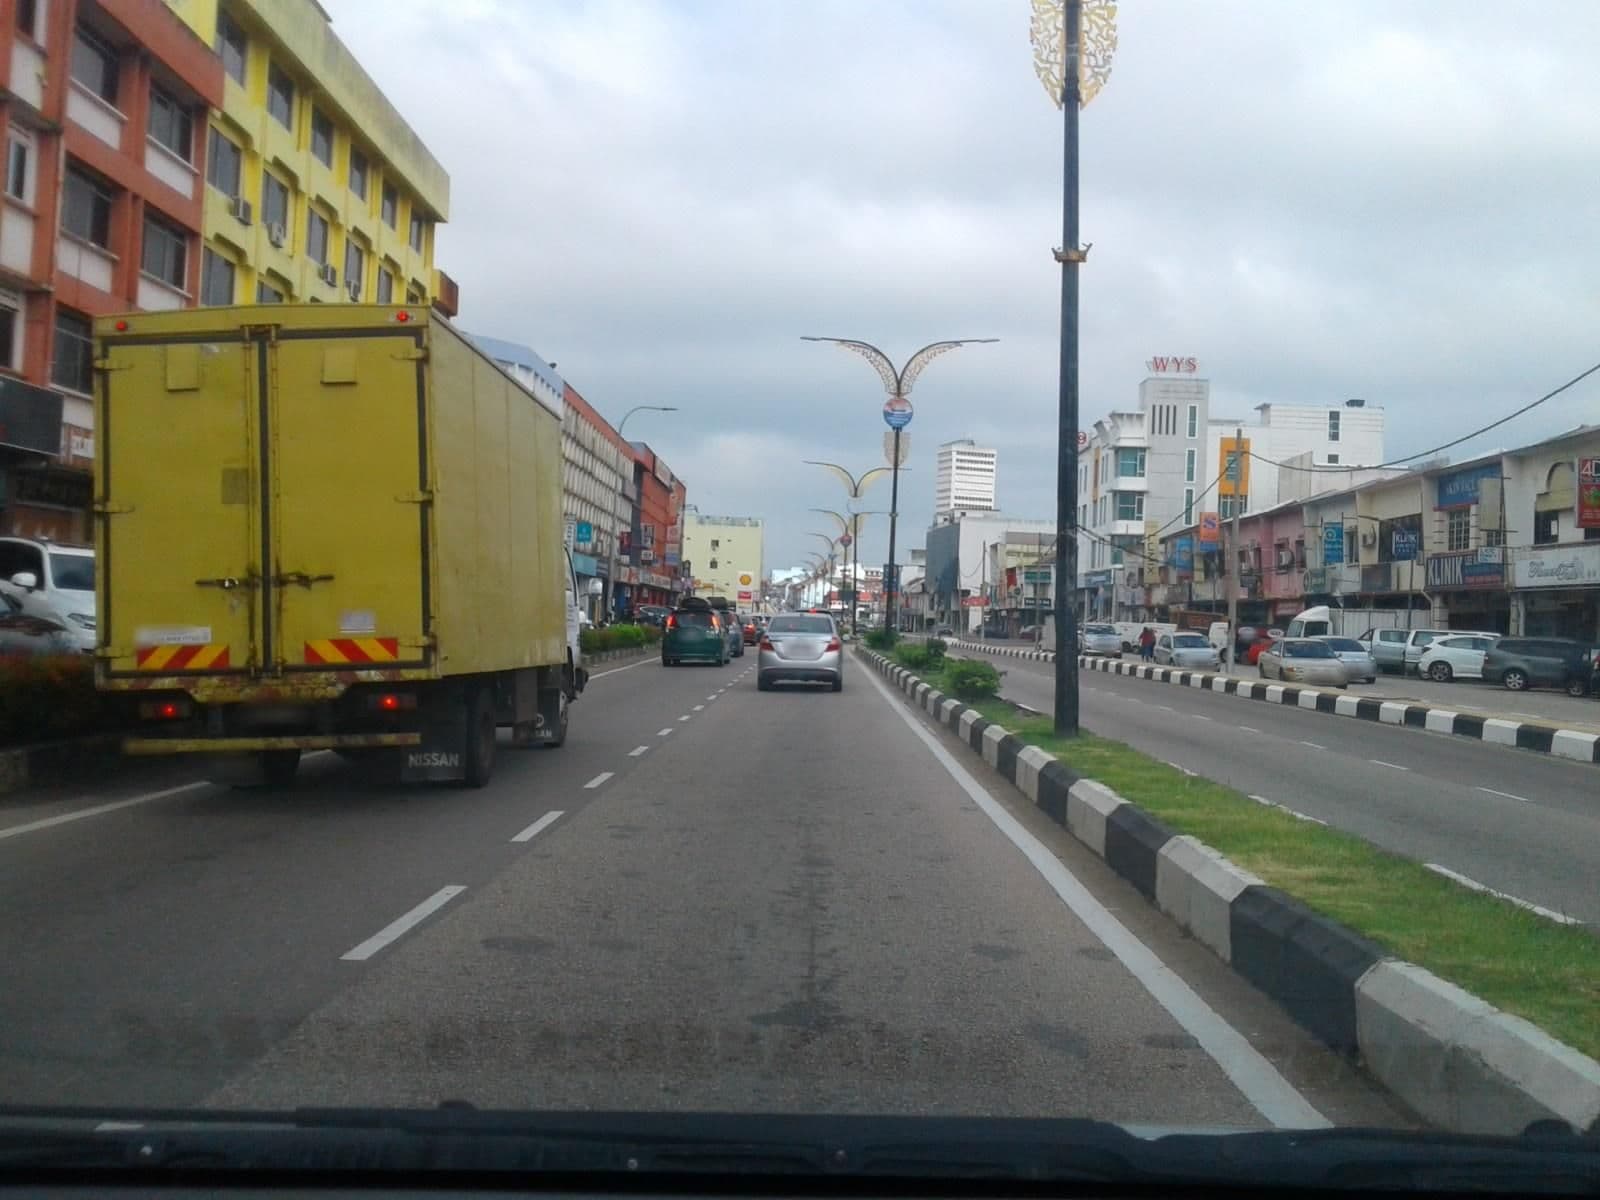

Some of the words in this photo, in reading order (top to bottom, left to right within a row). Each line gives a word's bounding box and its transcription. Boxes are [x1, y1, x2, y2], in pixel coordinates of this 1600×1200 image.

[1152, 356, 1197, 373] WYS
[1427, 556, 1463, 586] KLINIK
[408, 752, 459, 768] NISSAN
